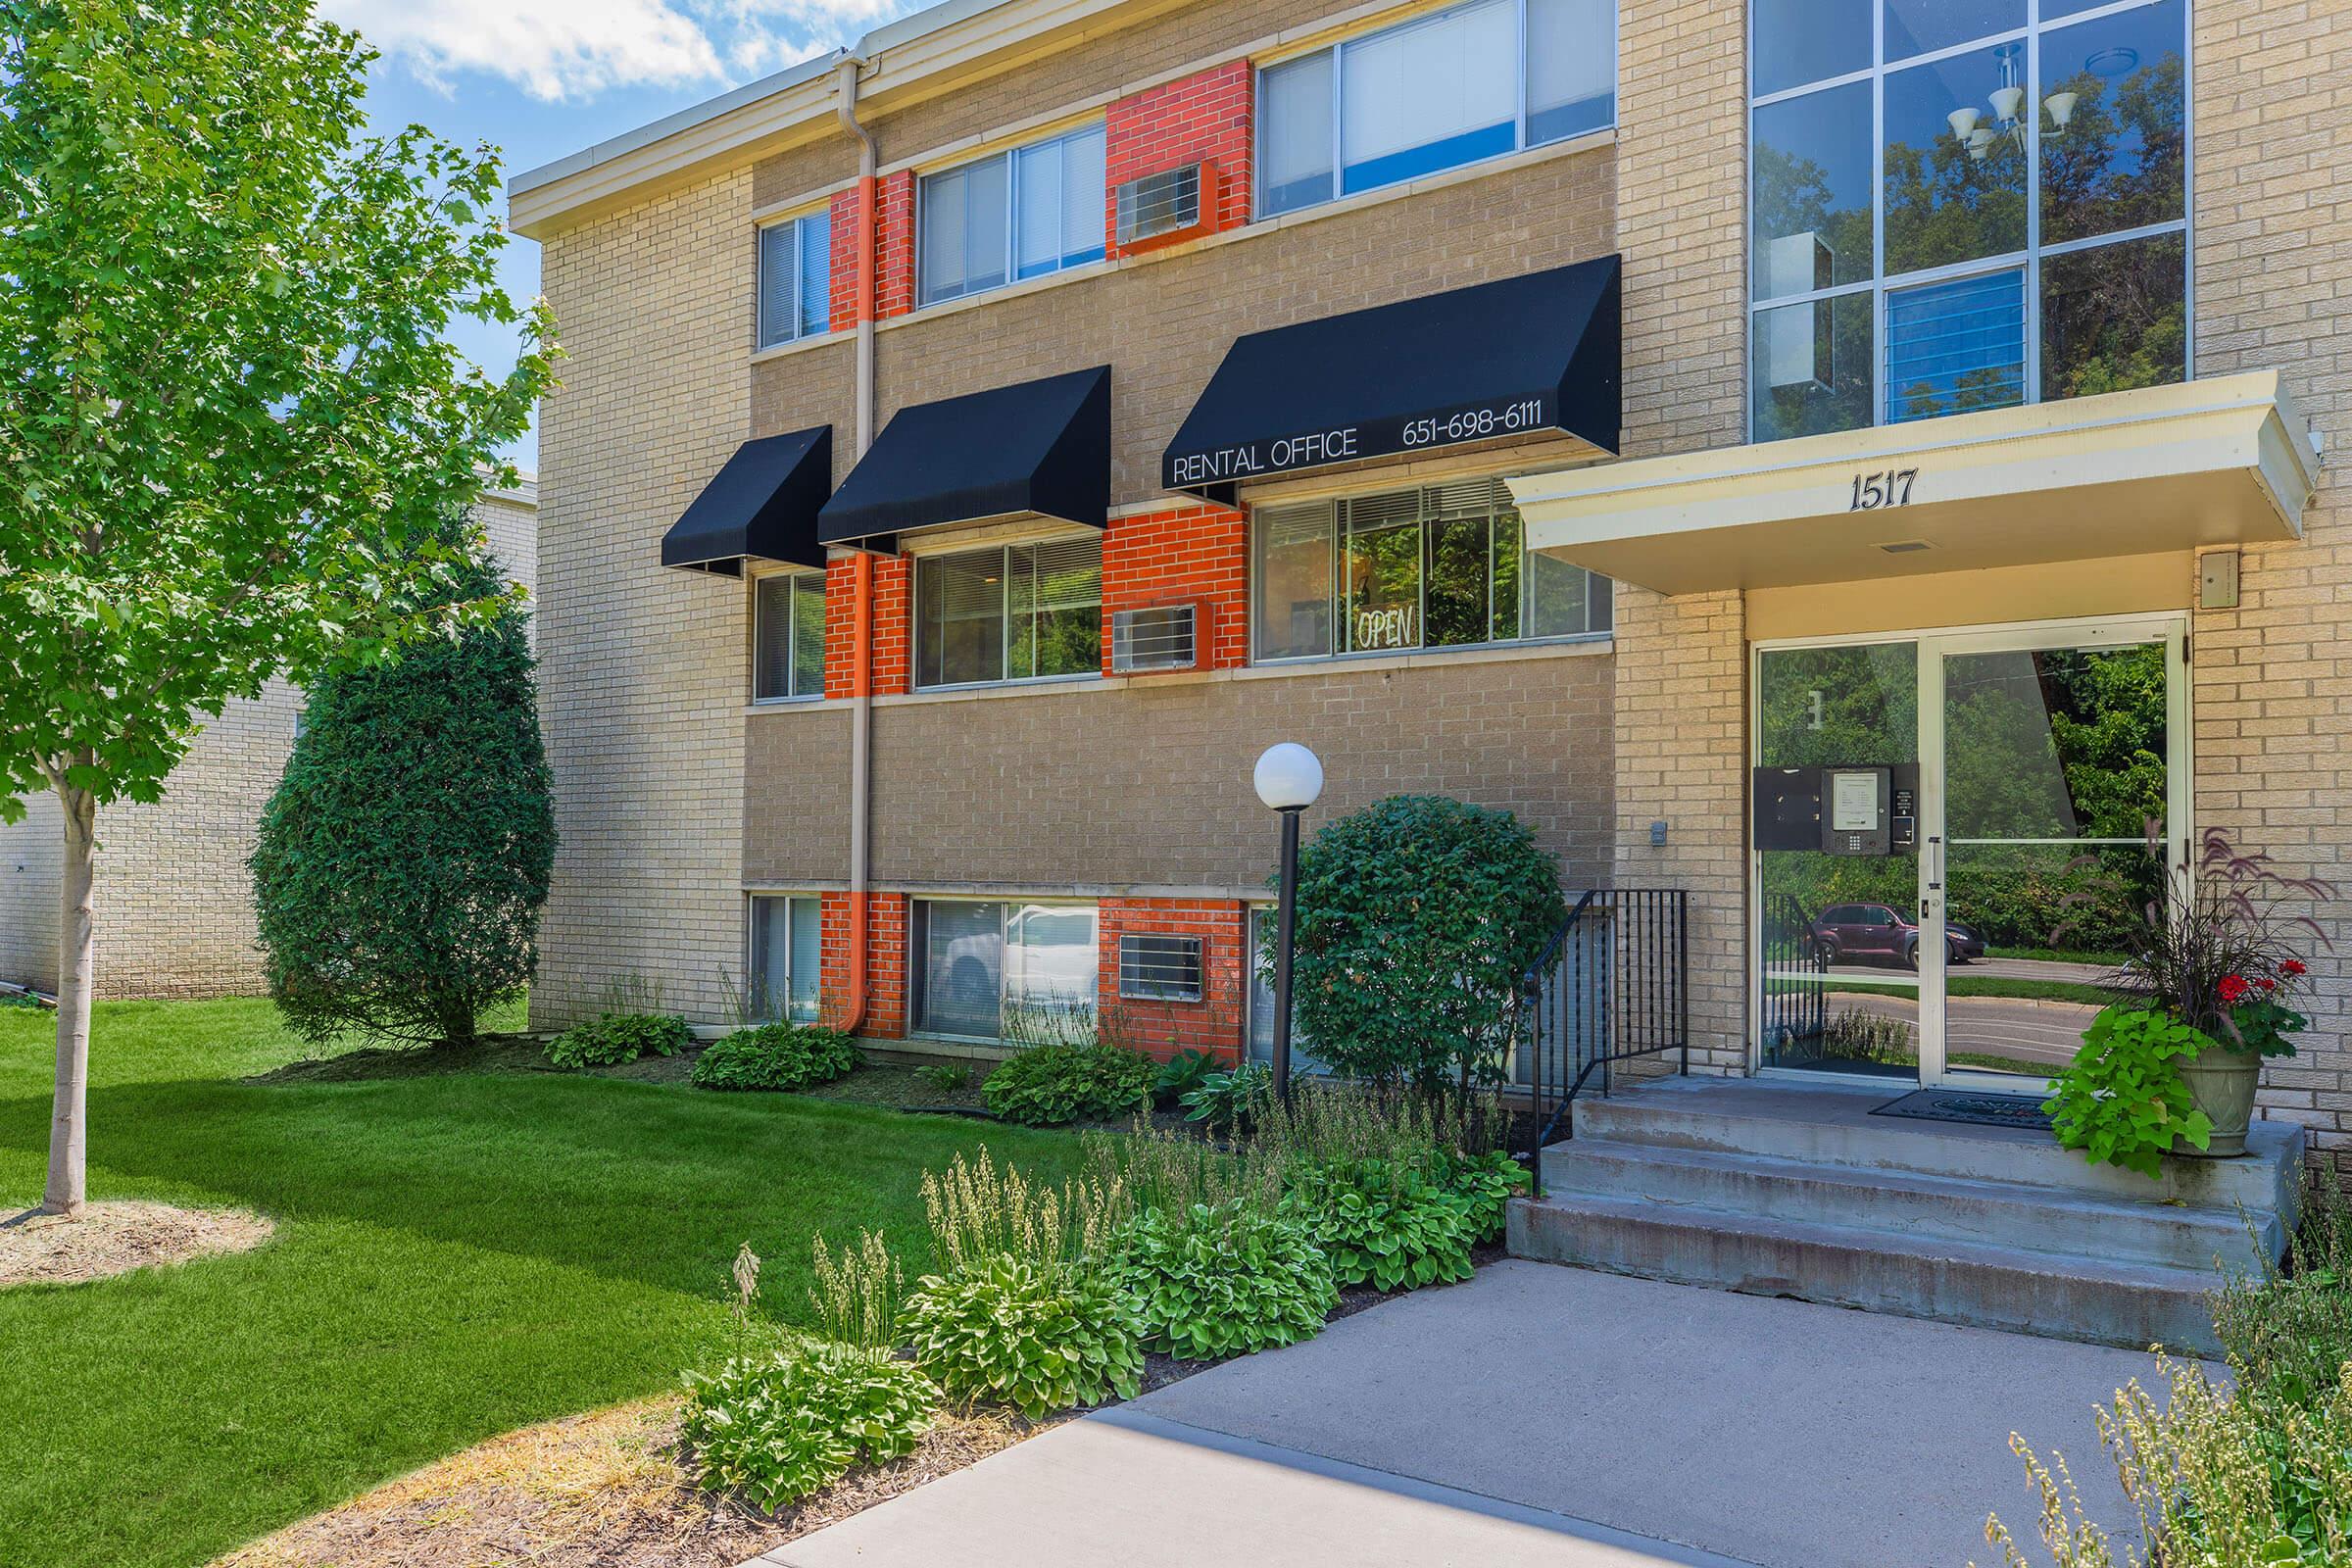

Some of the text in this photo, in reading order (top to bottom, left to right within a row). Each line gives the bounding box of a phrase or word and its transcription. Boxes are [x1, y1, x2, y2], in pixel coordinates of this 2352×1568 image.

[1174, 399, 1542, 483] RENTAL OFFICE 651-698-6111
[1850, 467, 1919, 512] 1517
[1358, 605, 1413, 648] OPEN
